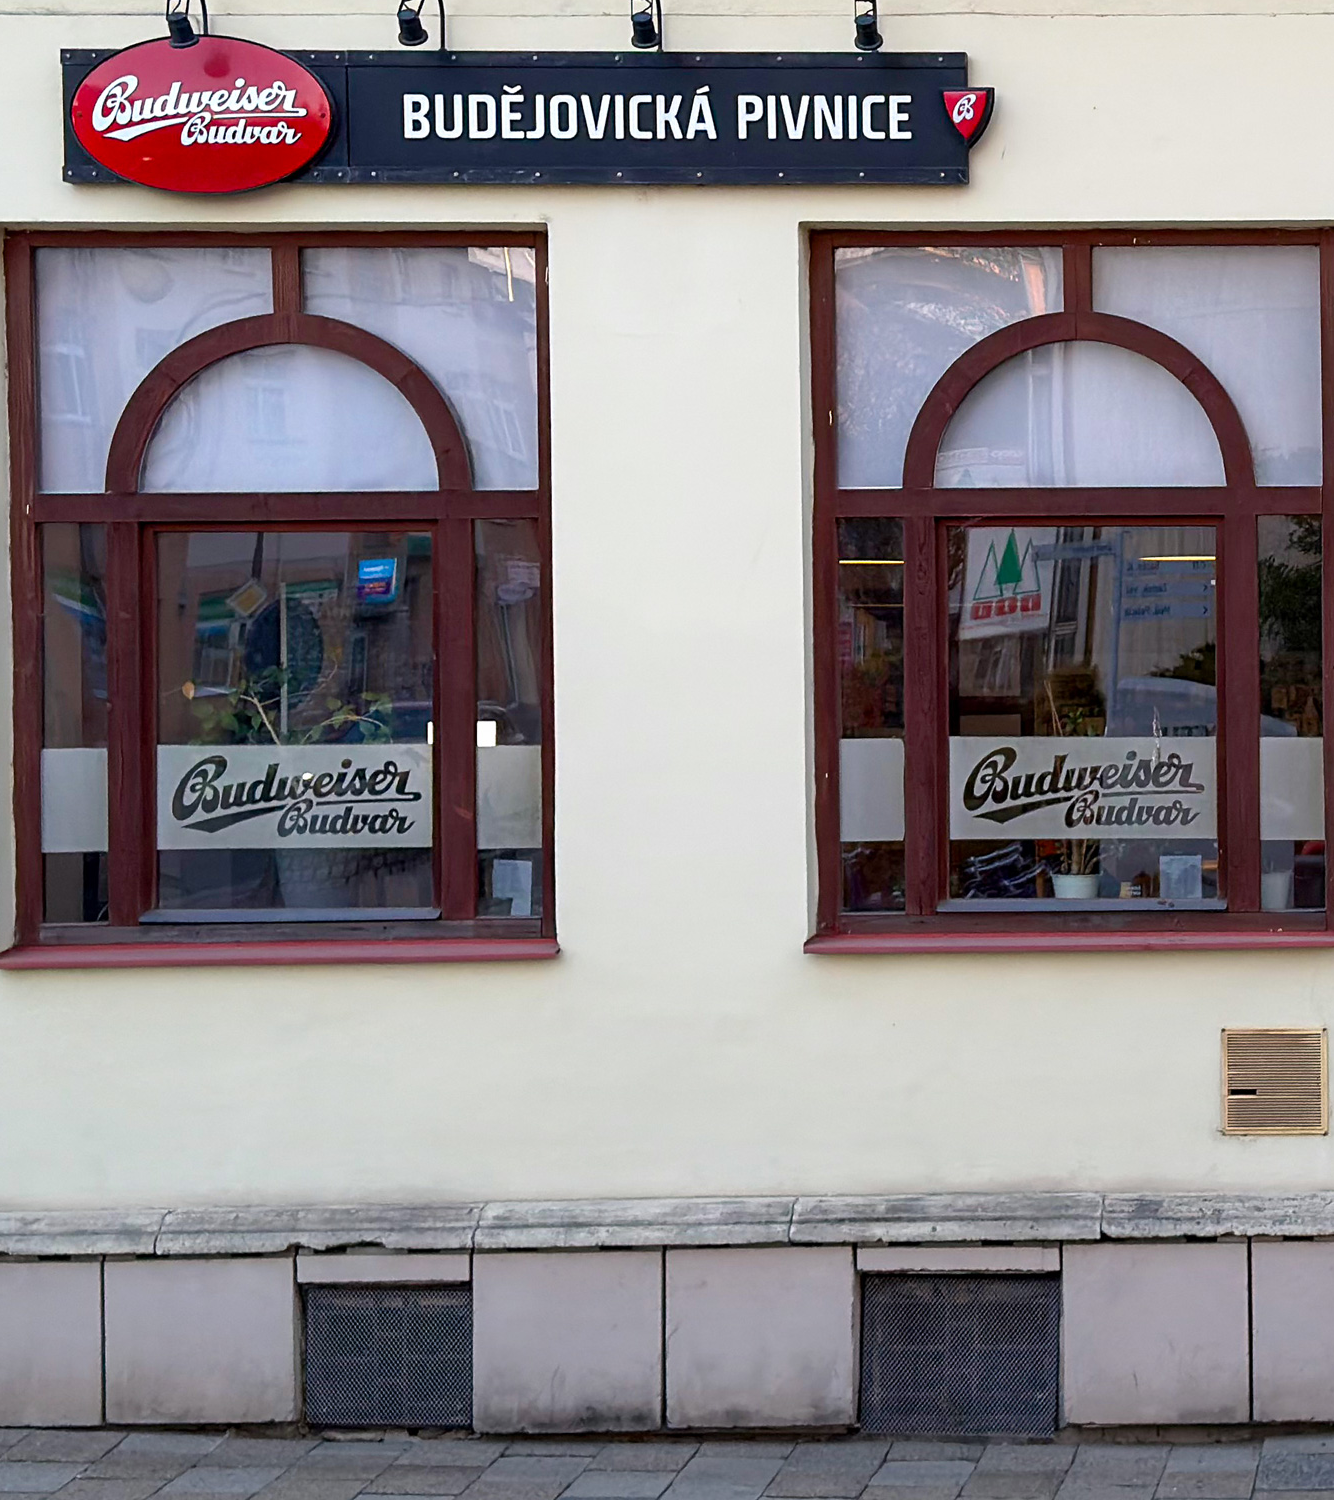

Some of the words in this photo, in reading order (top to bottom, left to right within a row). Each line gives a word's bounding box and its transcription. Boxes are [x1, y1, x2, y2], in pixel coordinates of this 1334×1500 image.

[91, 74, 308, 132] Budweiser
[180, 111, 302, 146] Budvar
[402, 84, 718, 140] BUDĚJOVICKÁ
[737, 94, 913, 140] PIVNICE
[171, 754, 423, 822] Budweiser
[962, 746, 1205, 812] Budweiser
[276, 798, 416, 839] Budvar
[1063, 788, 1201, 829] Budvar
